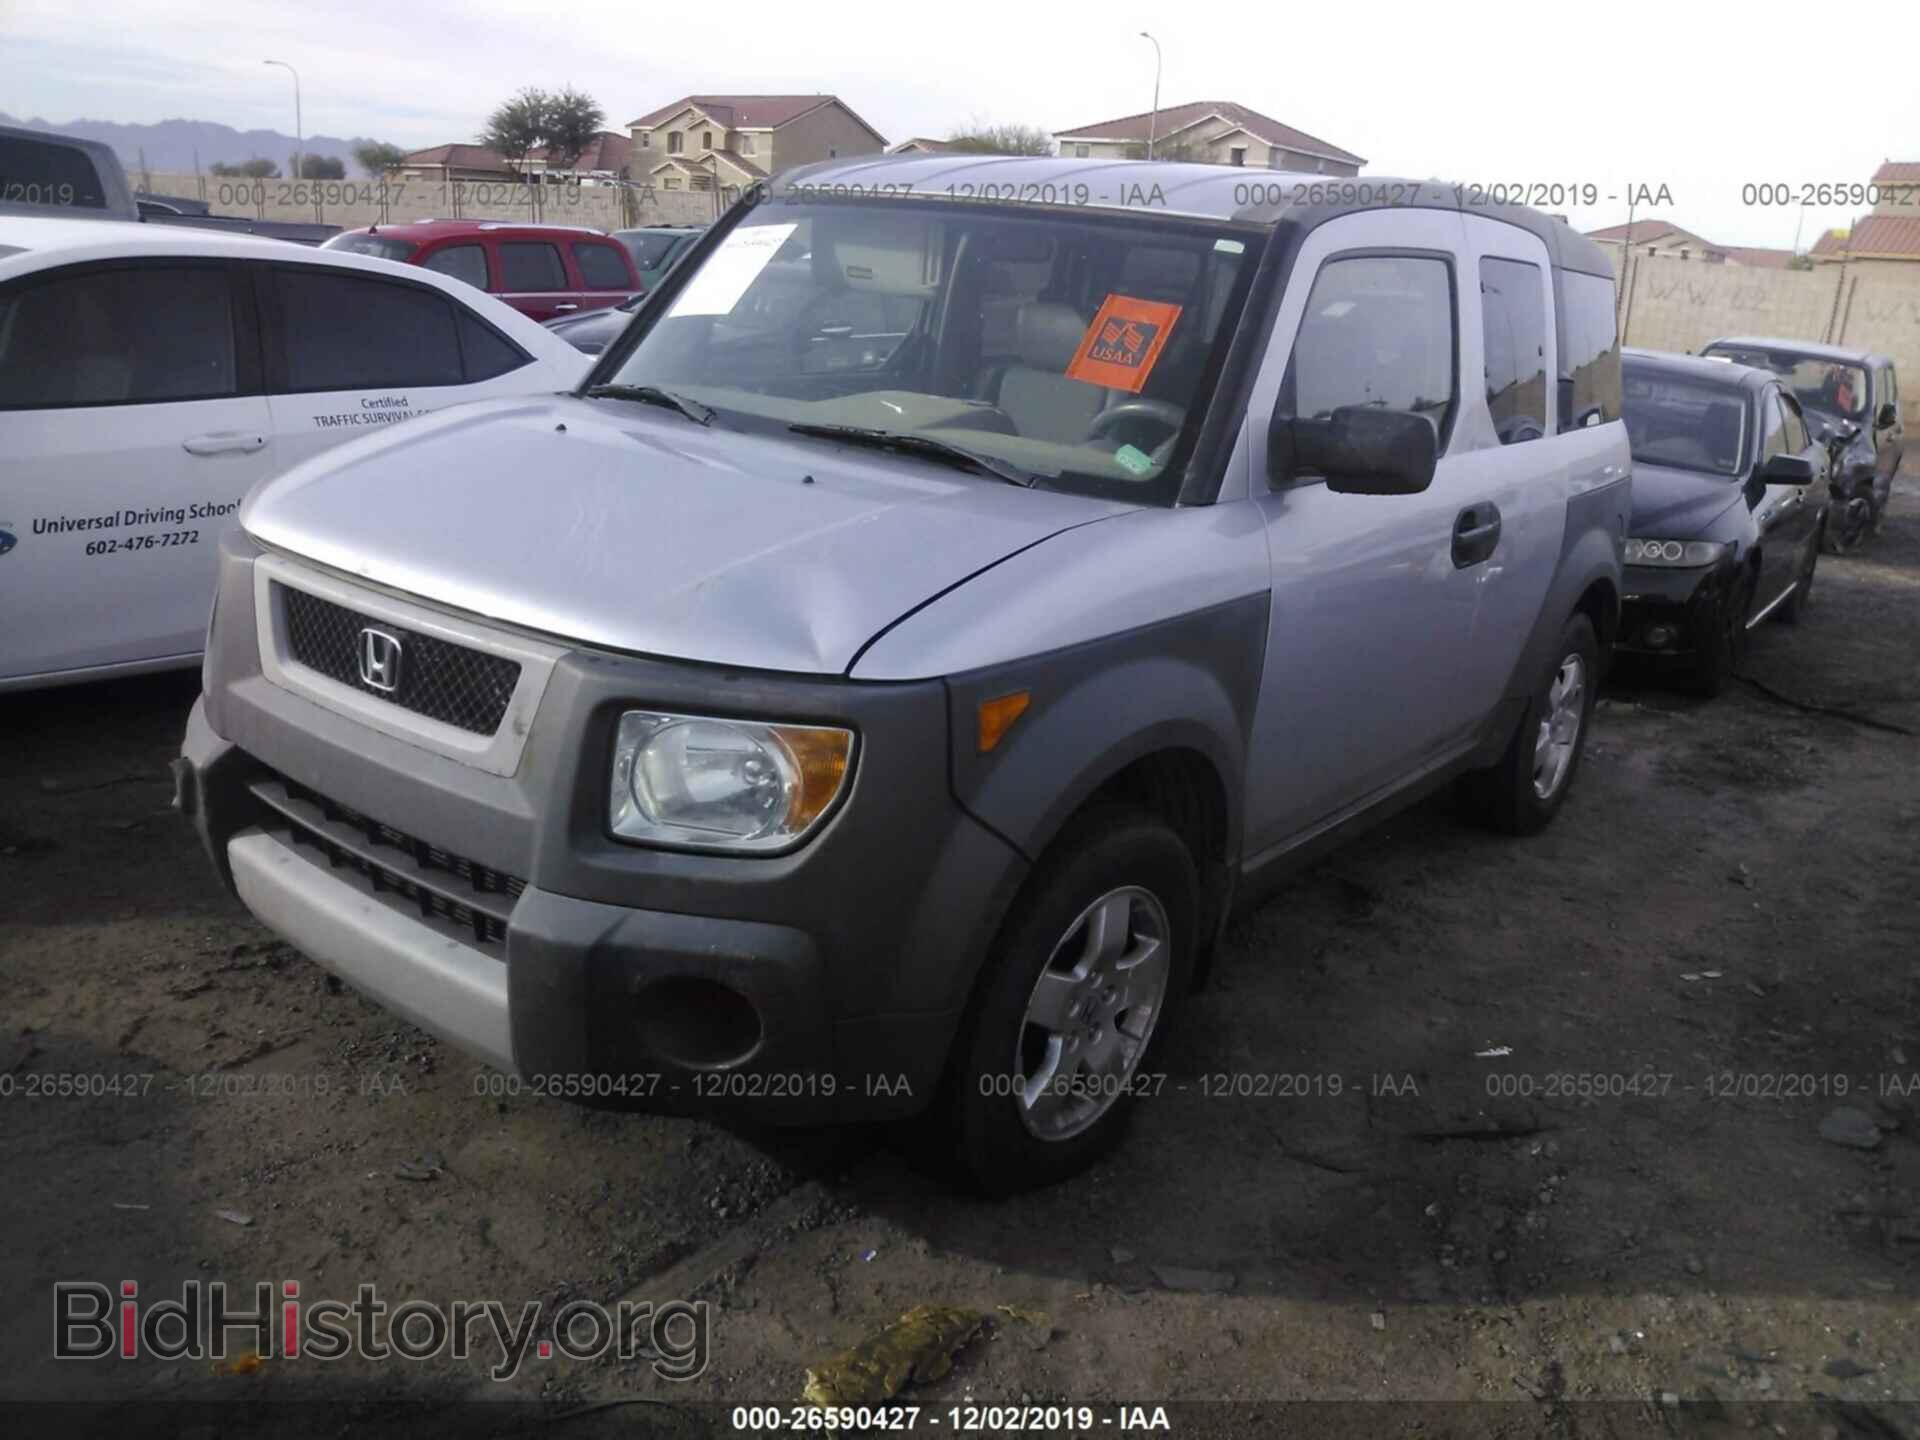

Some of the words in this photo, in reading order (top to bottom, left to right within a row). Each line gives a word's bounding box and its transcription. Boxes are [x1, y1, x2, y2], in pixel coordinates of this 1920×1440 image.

[1092, 345, 1134, 365] USAA
[312, 414, 361, 427] TRAFFIC
[33, 511, 120, 534] Universal
[124, 507, 185, 526] Driving
[86, 530, 199, 556] 602-476-7272
